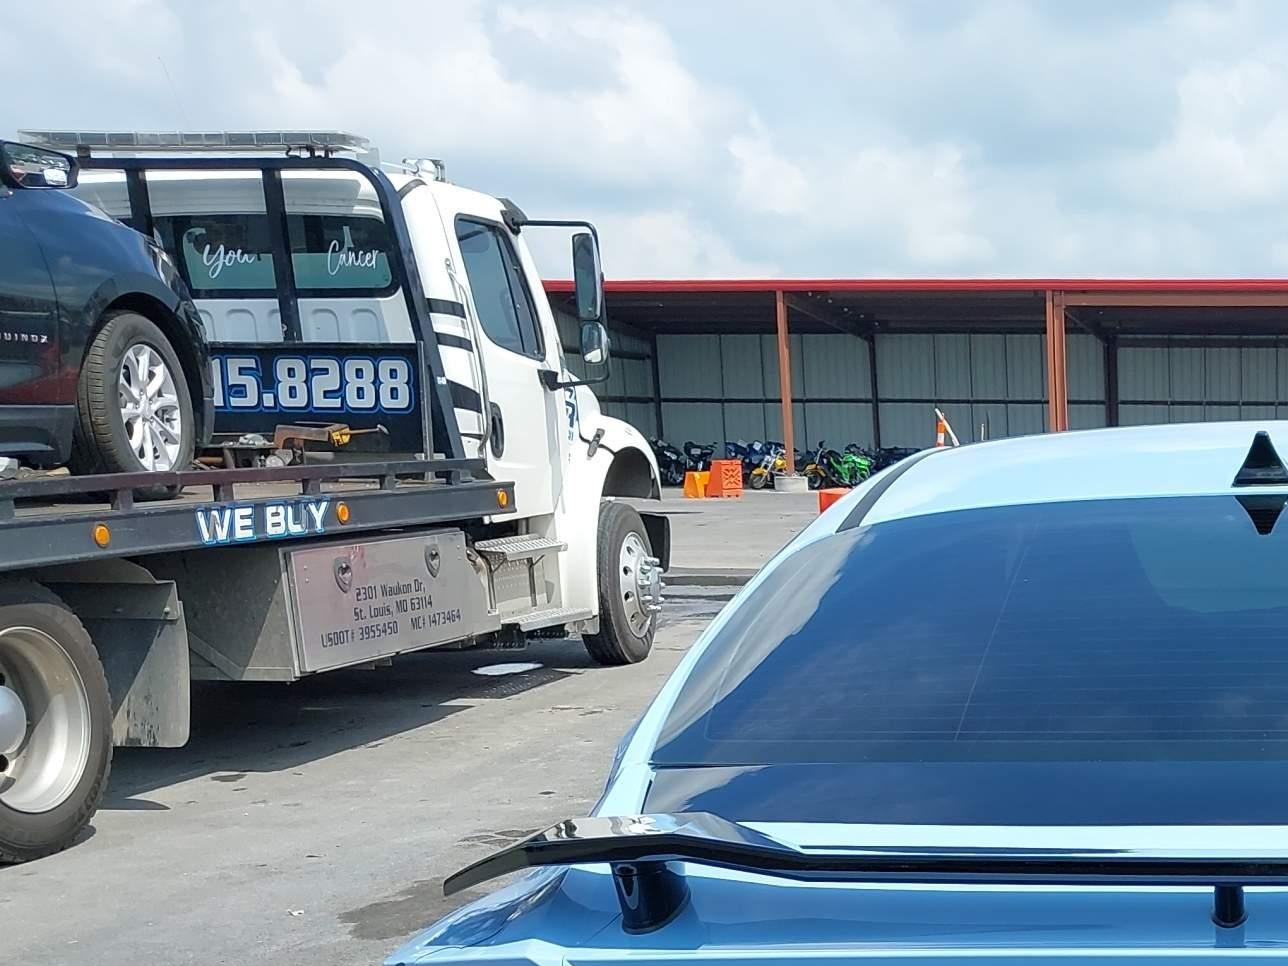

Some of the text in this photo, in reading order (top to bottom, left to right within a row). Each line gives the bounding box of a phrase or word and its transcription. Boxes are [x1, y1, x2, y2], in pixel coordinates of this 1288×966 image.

[203, 239, 379, 279] You Cancer
[0, 332, 48, 343] UINOX
[197, 498, 329, 544] WE BUY
[355, 578, 426, 602] 2301 Waukon Dr,
[353, 594, 433, 622] St. Louis, MO 63114
[359, 620, 399, 641] 3955450
[428, 608, 461, 627] 1473464
